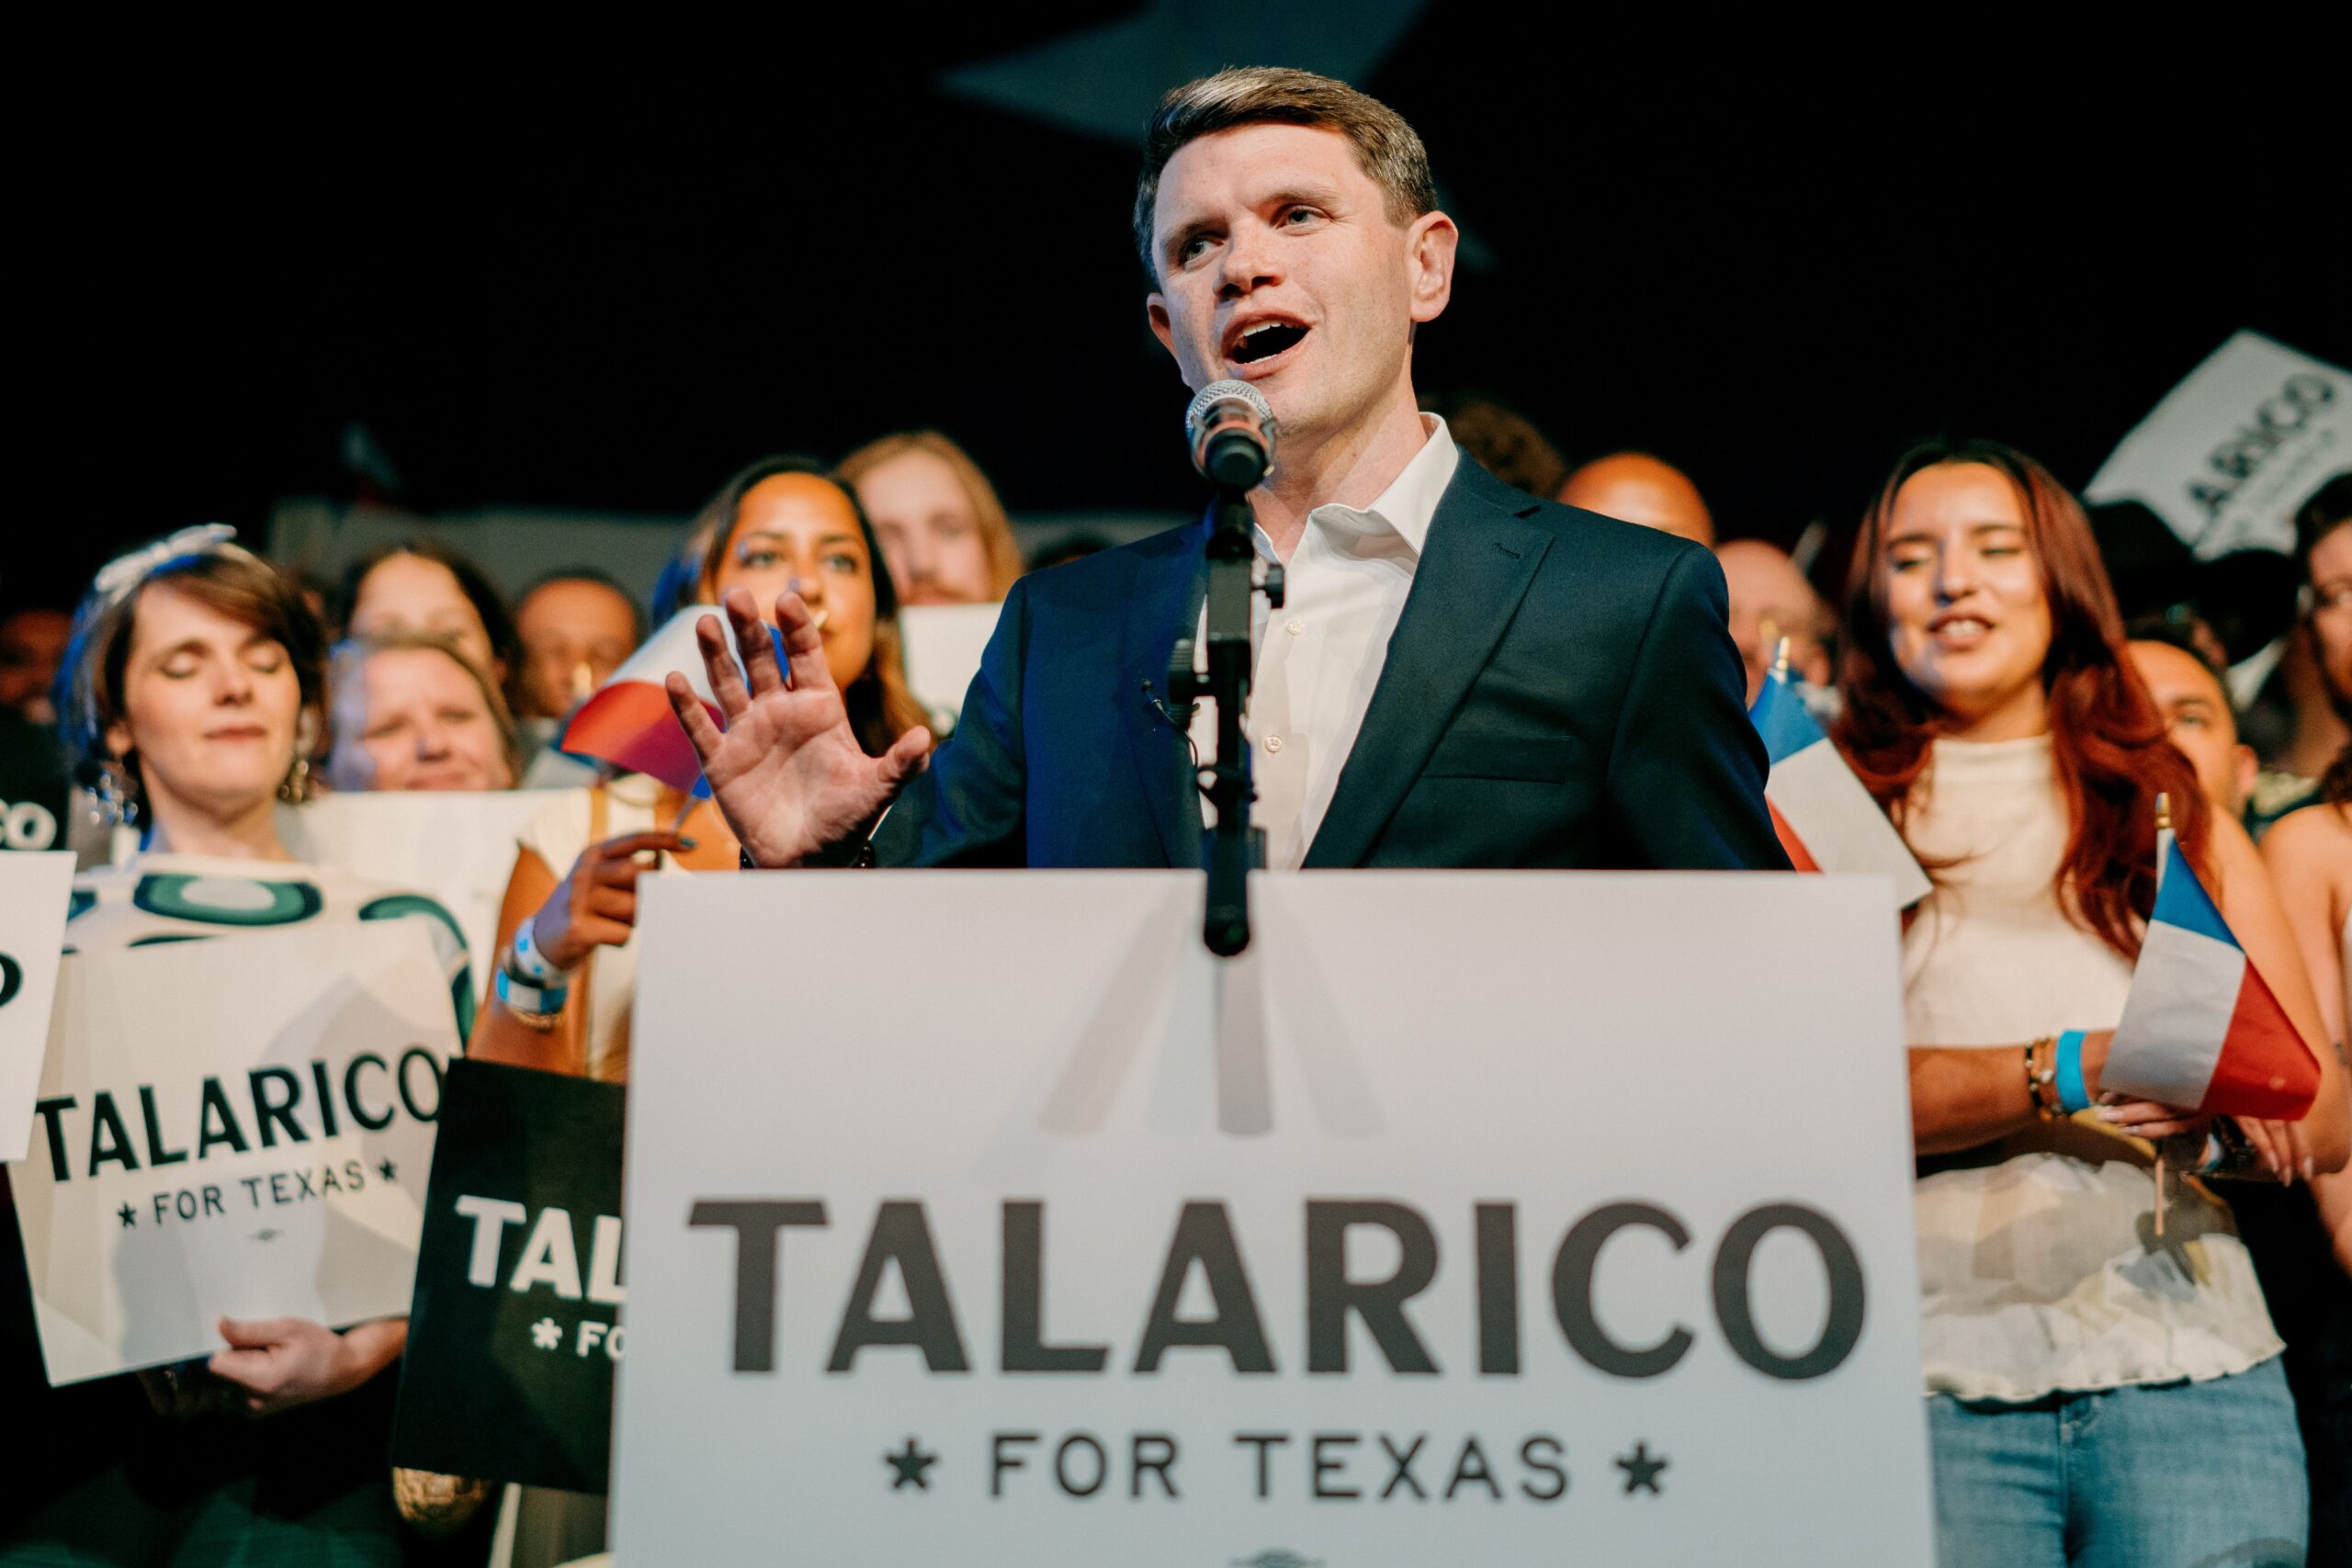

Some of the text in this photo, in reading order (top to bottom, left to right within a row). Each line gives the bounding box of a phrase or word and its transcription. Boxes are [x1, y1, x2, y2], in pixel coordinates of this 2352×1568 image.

[0, 797, 57, 851] O
[34, 1044, 444, 1182] TALARICO
[153, 1159, 366, 1225] FOR TEXAS
[455, 1194, 626, 1305] TAL
[688, 1199, 1867, 1382] TALARICO
[989, 1433, 1569, 1503] FOR TEXAS
